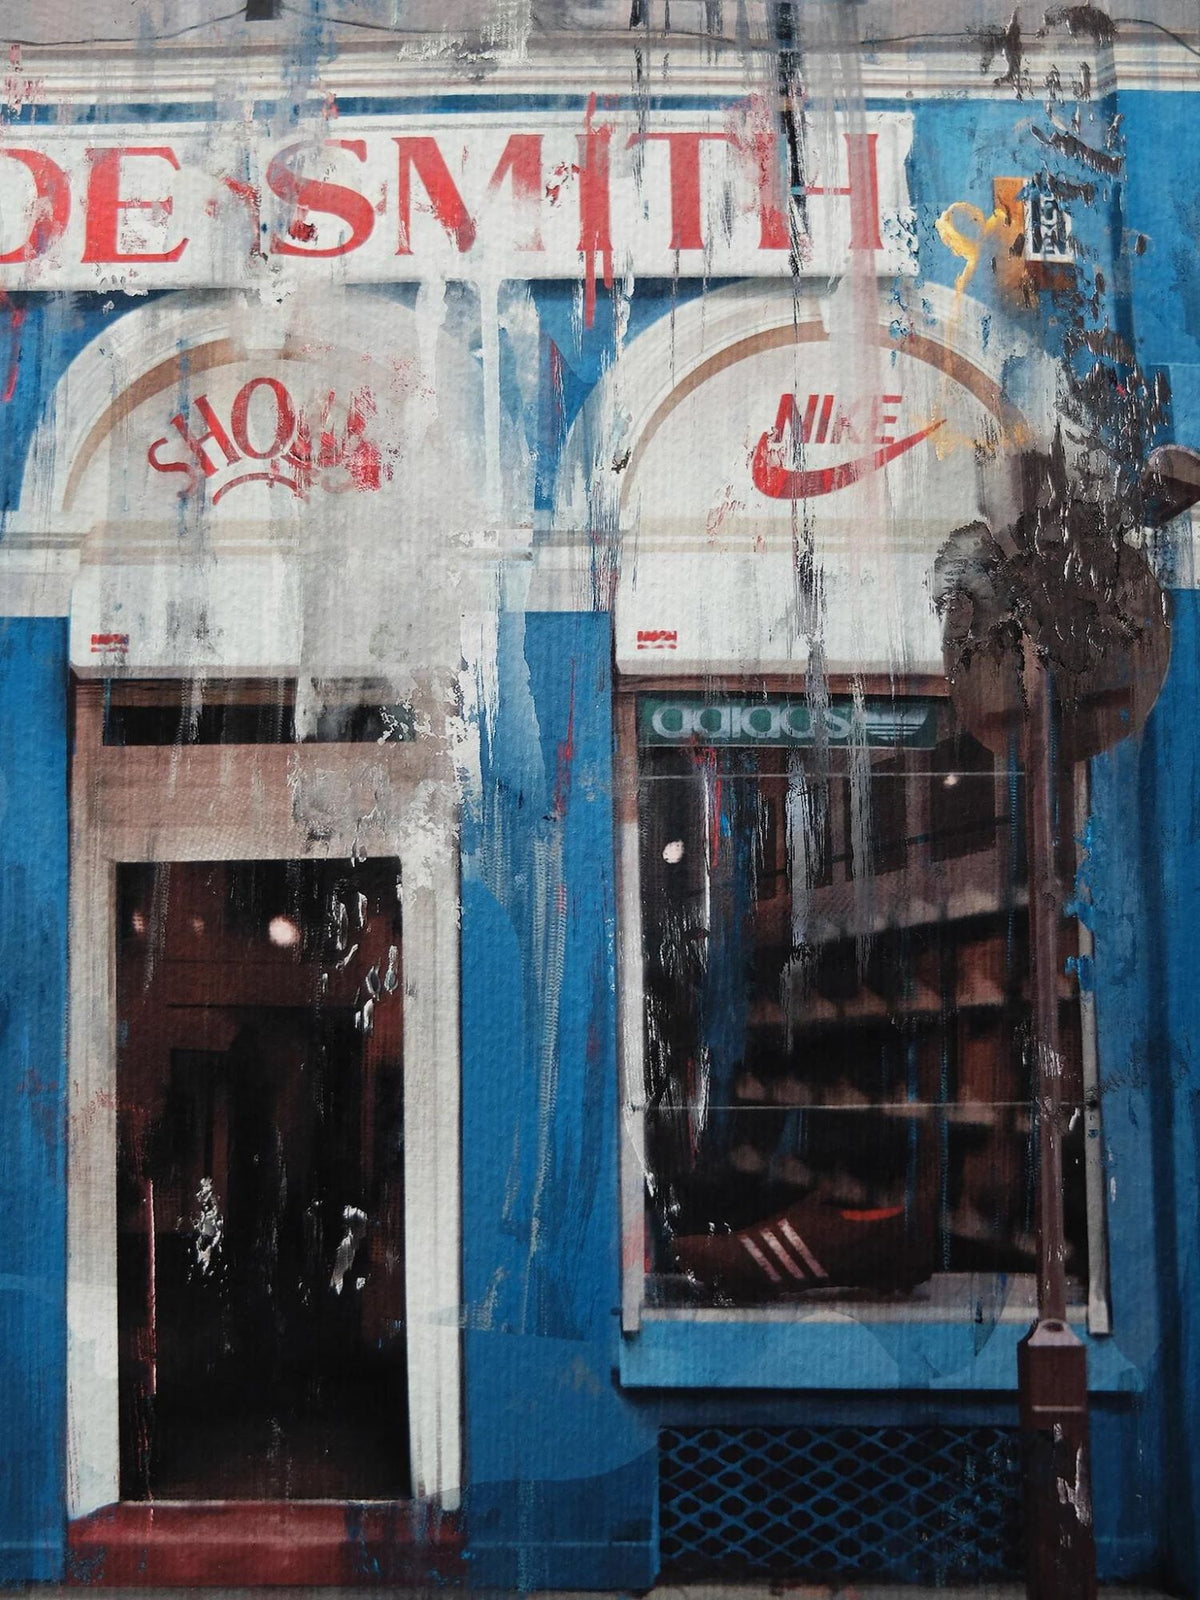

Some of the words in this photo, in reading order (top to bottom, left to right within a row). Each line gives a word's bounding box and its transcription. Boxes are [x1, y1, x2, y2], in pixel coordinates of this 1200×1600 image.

[266, 131, 885, 258] SMITH
[774, 393, 903, 444] NIKE
[651, 704, 850, 740] adidas
